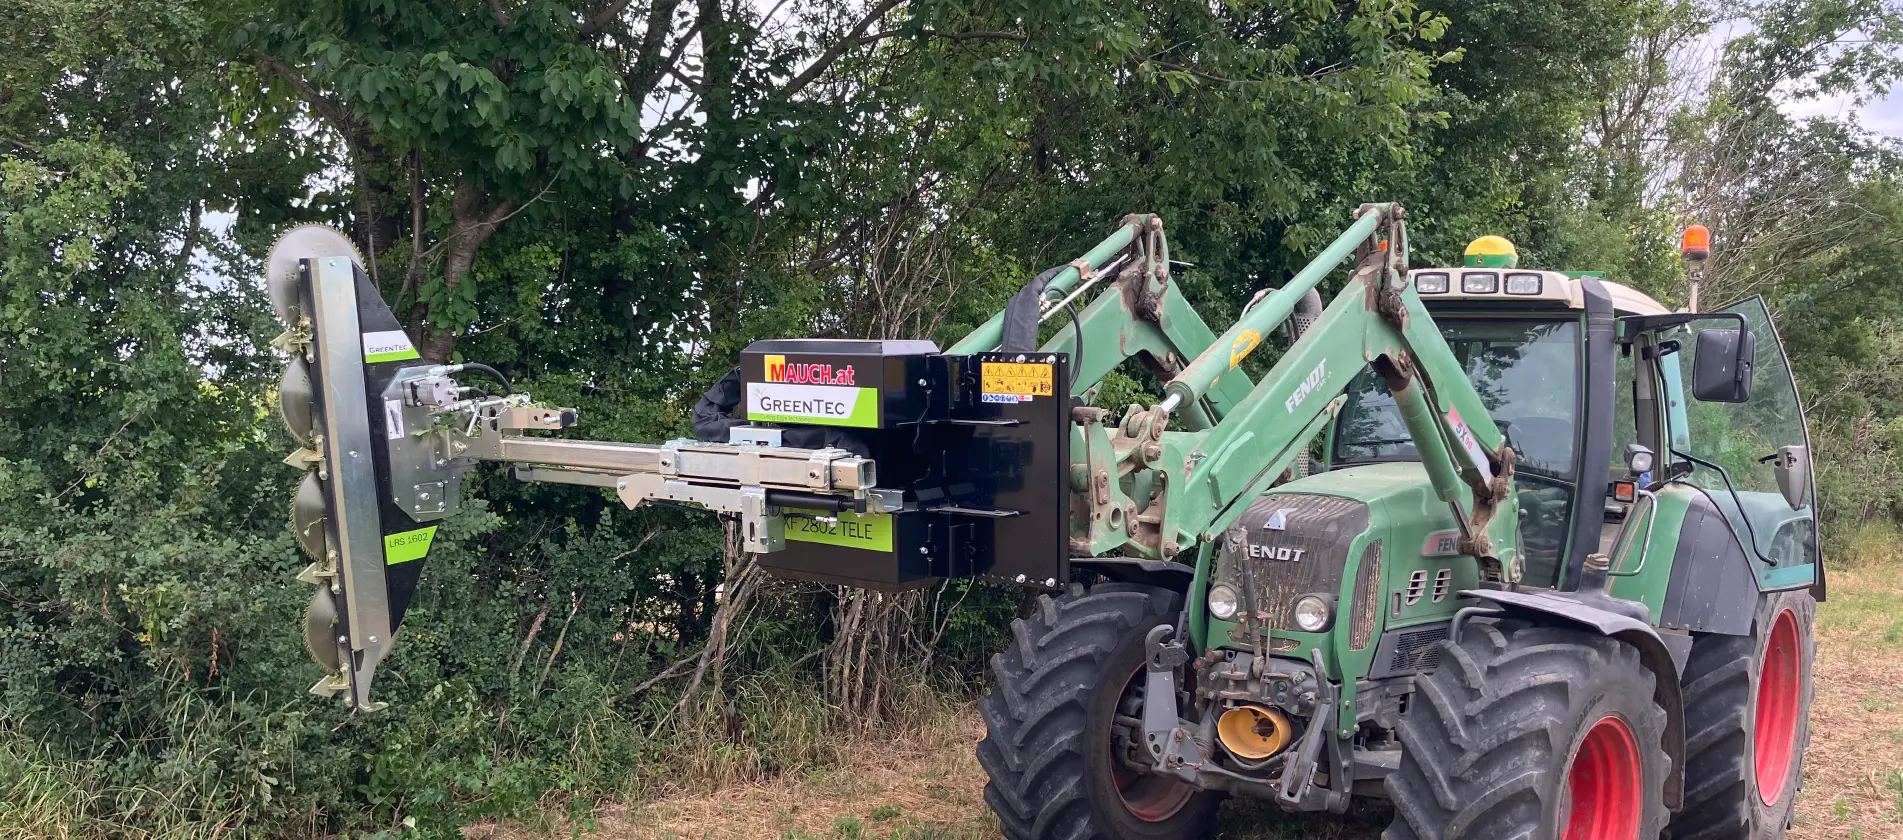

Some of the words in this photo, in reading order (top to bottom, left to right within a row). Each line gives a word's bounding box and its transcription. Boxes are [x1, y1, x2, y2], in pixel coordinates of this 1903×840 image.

[770, 363, 855, 386] MAUCH.at
[1285, 357, 1327, 415] FENDT
[840, 521, 873, 540] TELE
[389, 537, 405, 548] LRS
[407, 532, 428, 544] 1602
[1438, 537, 1457, 552] FEN
[1249, 544, 1306, 562] ENDT
